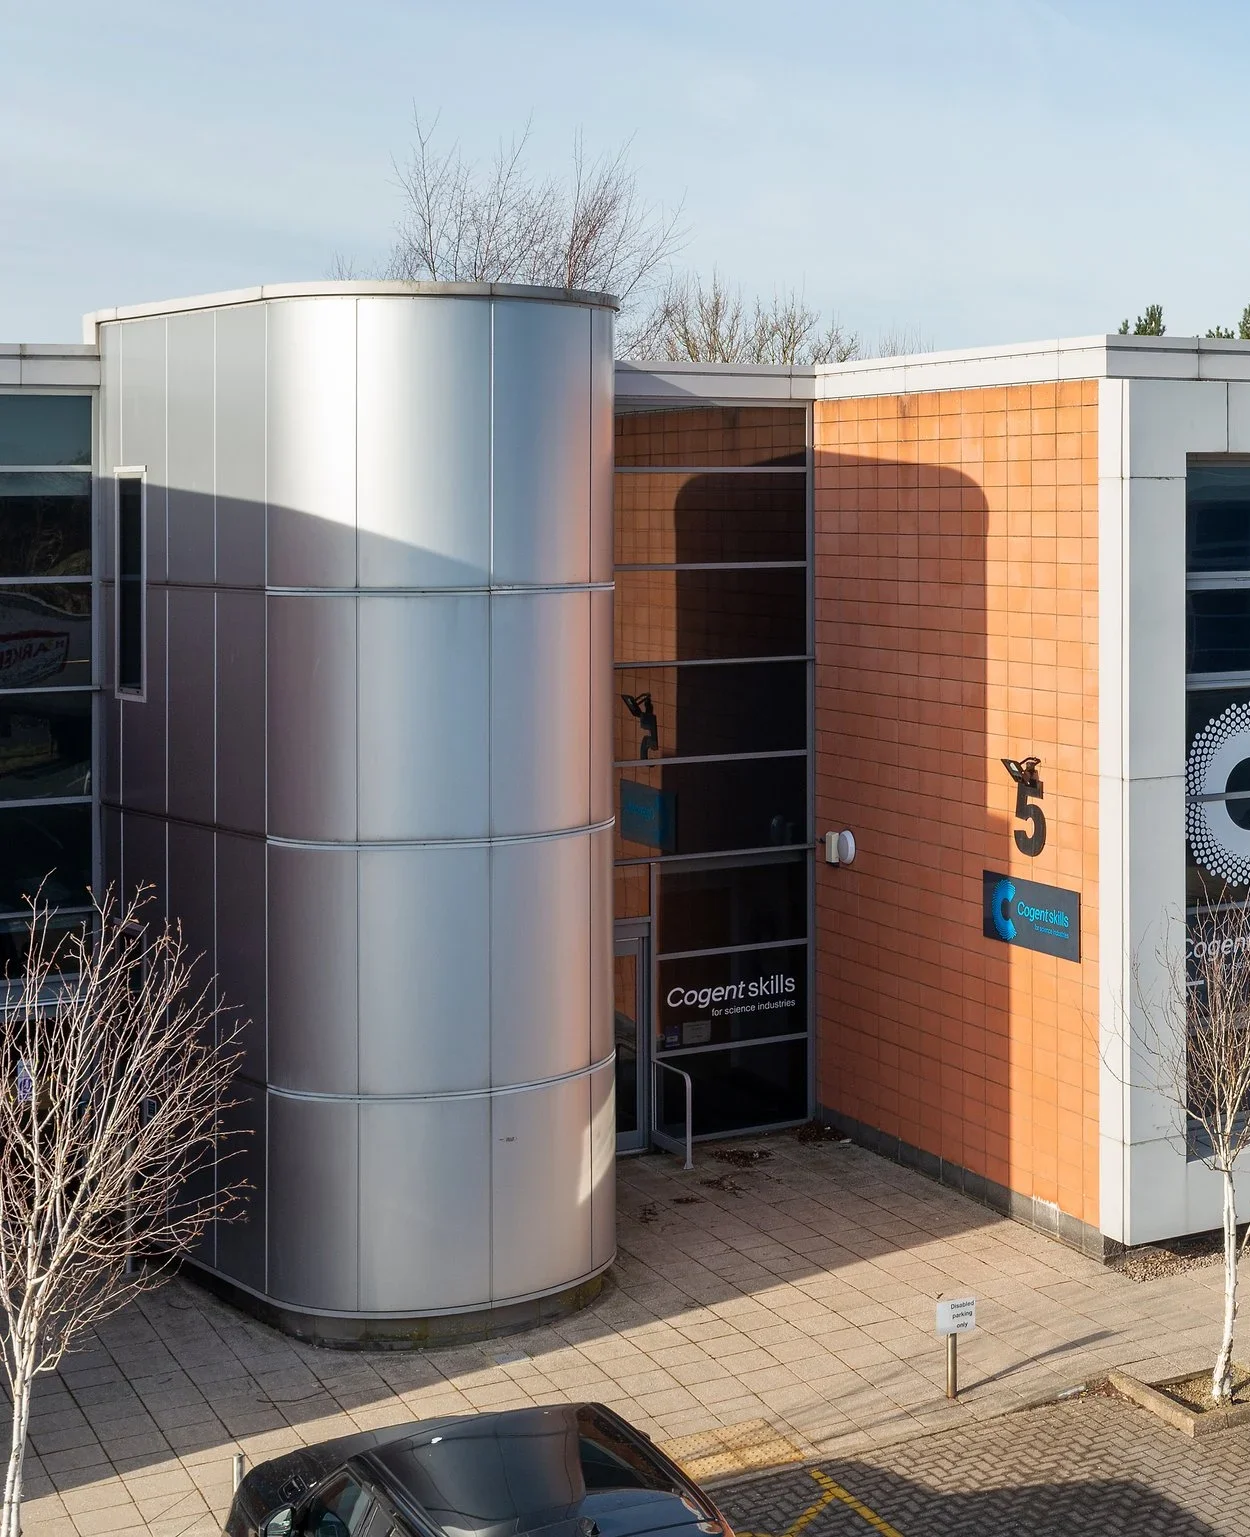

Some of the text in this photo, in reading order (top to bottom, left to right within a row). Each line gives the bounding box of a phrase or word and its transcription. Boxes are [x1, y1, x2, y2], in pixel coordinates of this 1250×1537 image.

[1014, 779, 1046, 857] 5
[1017, 901, 1069, 928] Cogent skills
[667, 974, 796, 1008] Cogent skills
[711, 998, 796, 1016] for science industries
[950, 1300, 975, 1309] Disabled
[952, 1311, 973, 1319] parking
